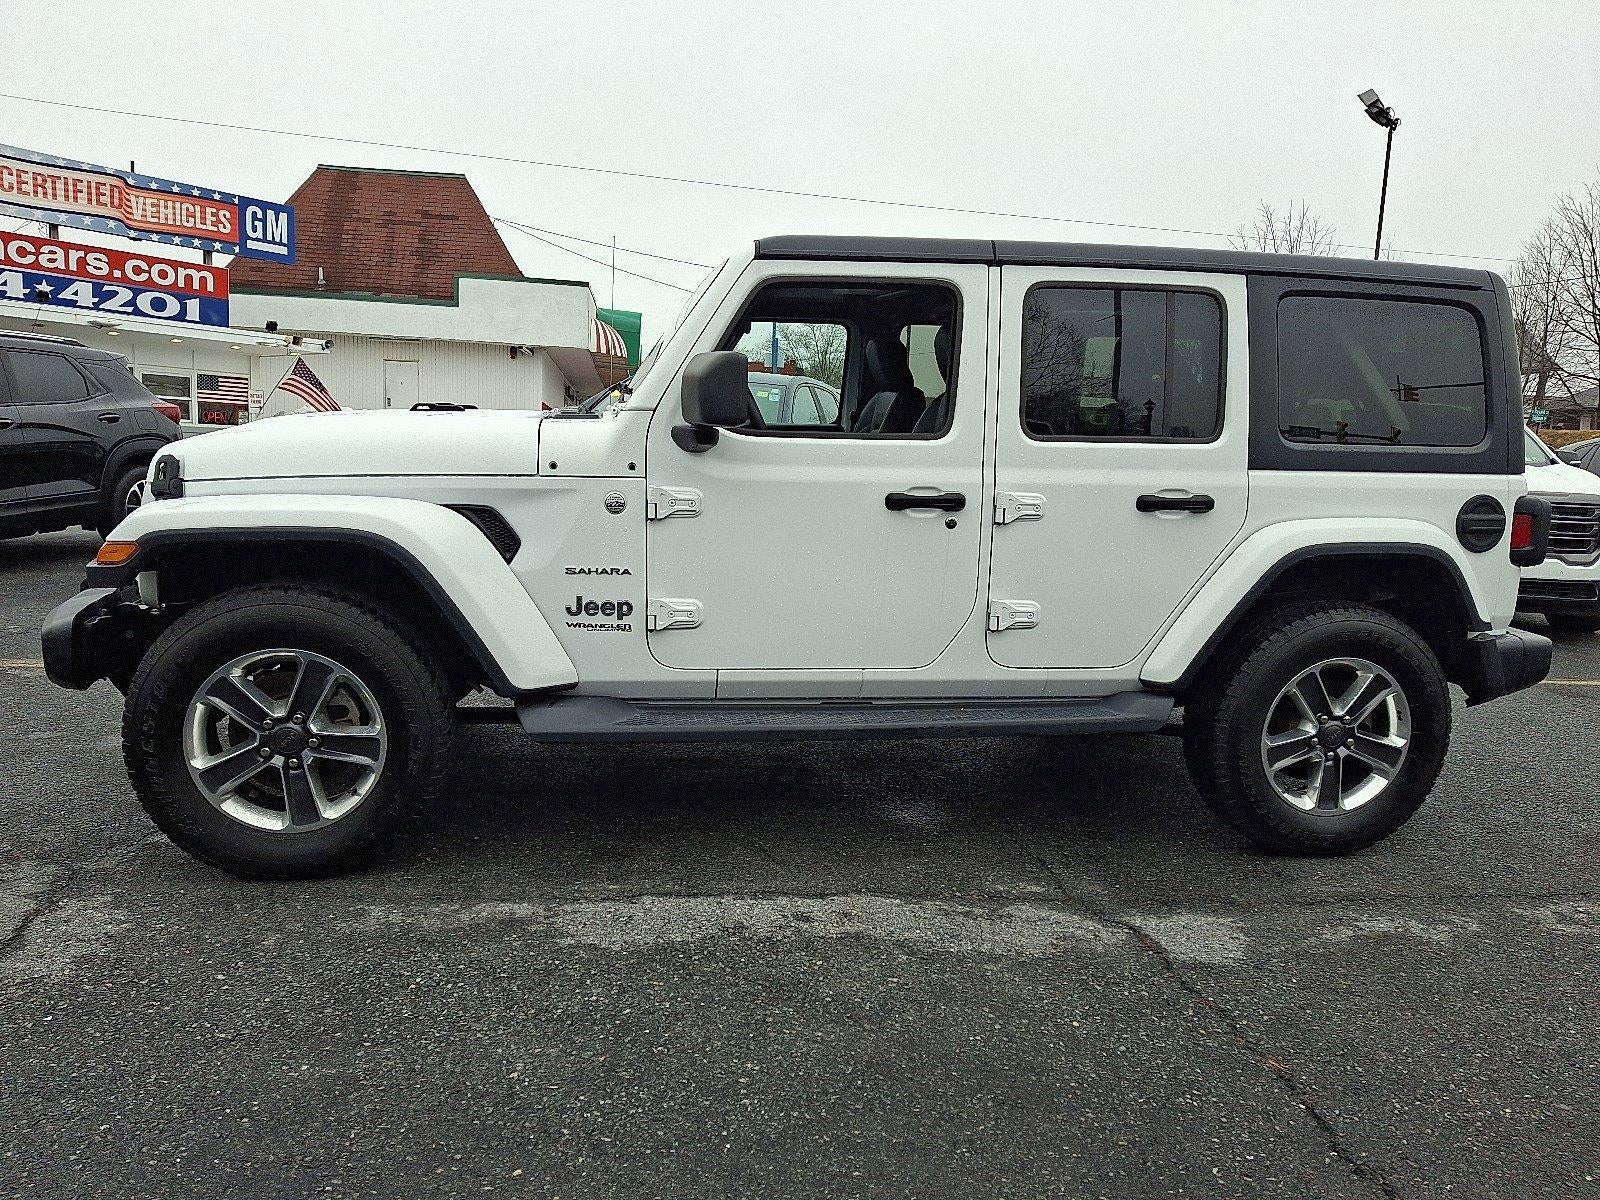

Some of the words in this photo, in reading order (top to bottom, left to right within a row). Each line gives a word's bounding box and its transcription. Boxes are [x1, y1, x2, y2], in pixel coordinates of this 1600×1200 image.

[0, 165, 124, 210] CERTIFIED
[129, 194, 232, 234] VEHICLES
[245, 205, 288, 245] GM
[0, 239, 214, 293] cars.com
[203, 410, 228, 423] OPEN
[564, 567, 632, 576] SAHARA
[565, 595, 633, 621] Jeep
[565, 621, 632, 630] WRANGLER
